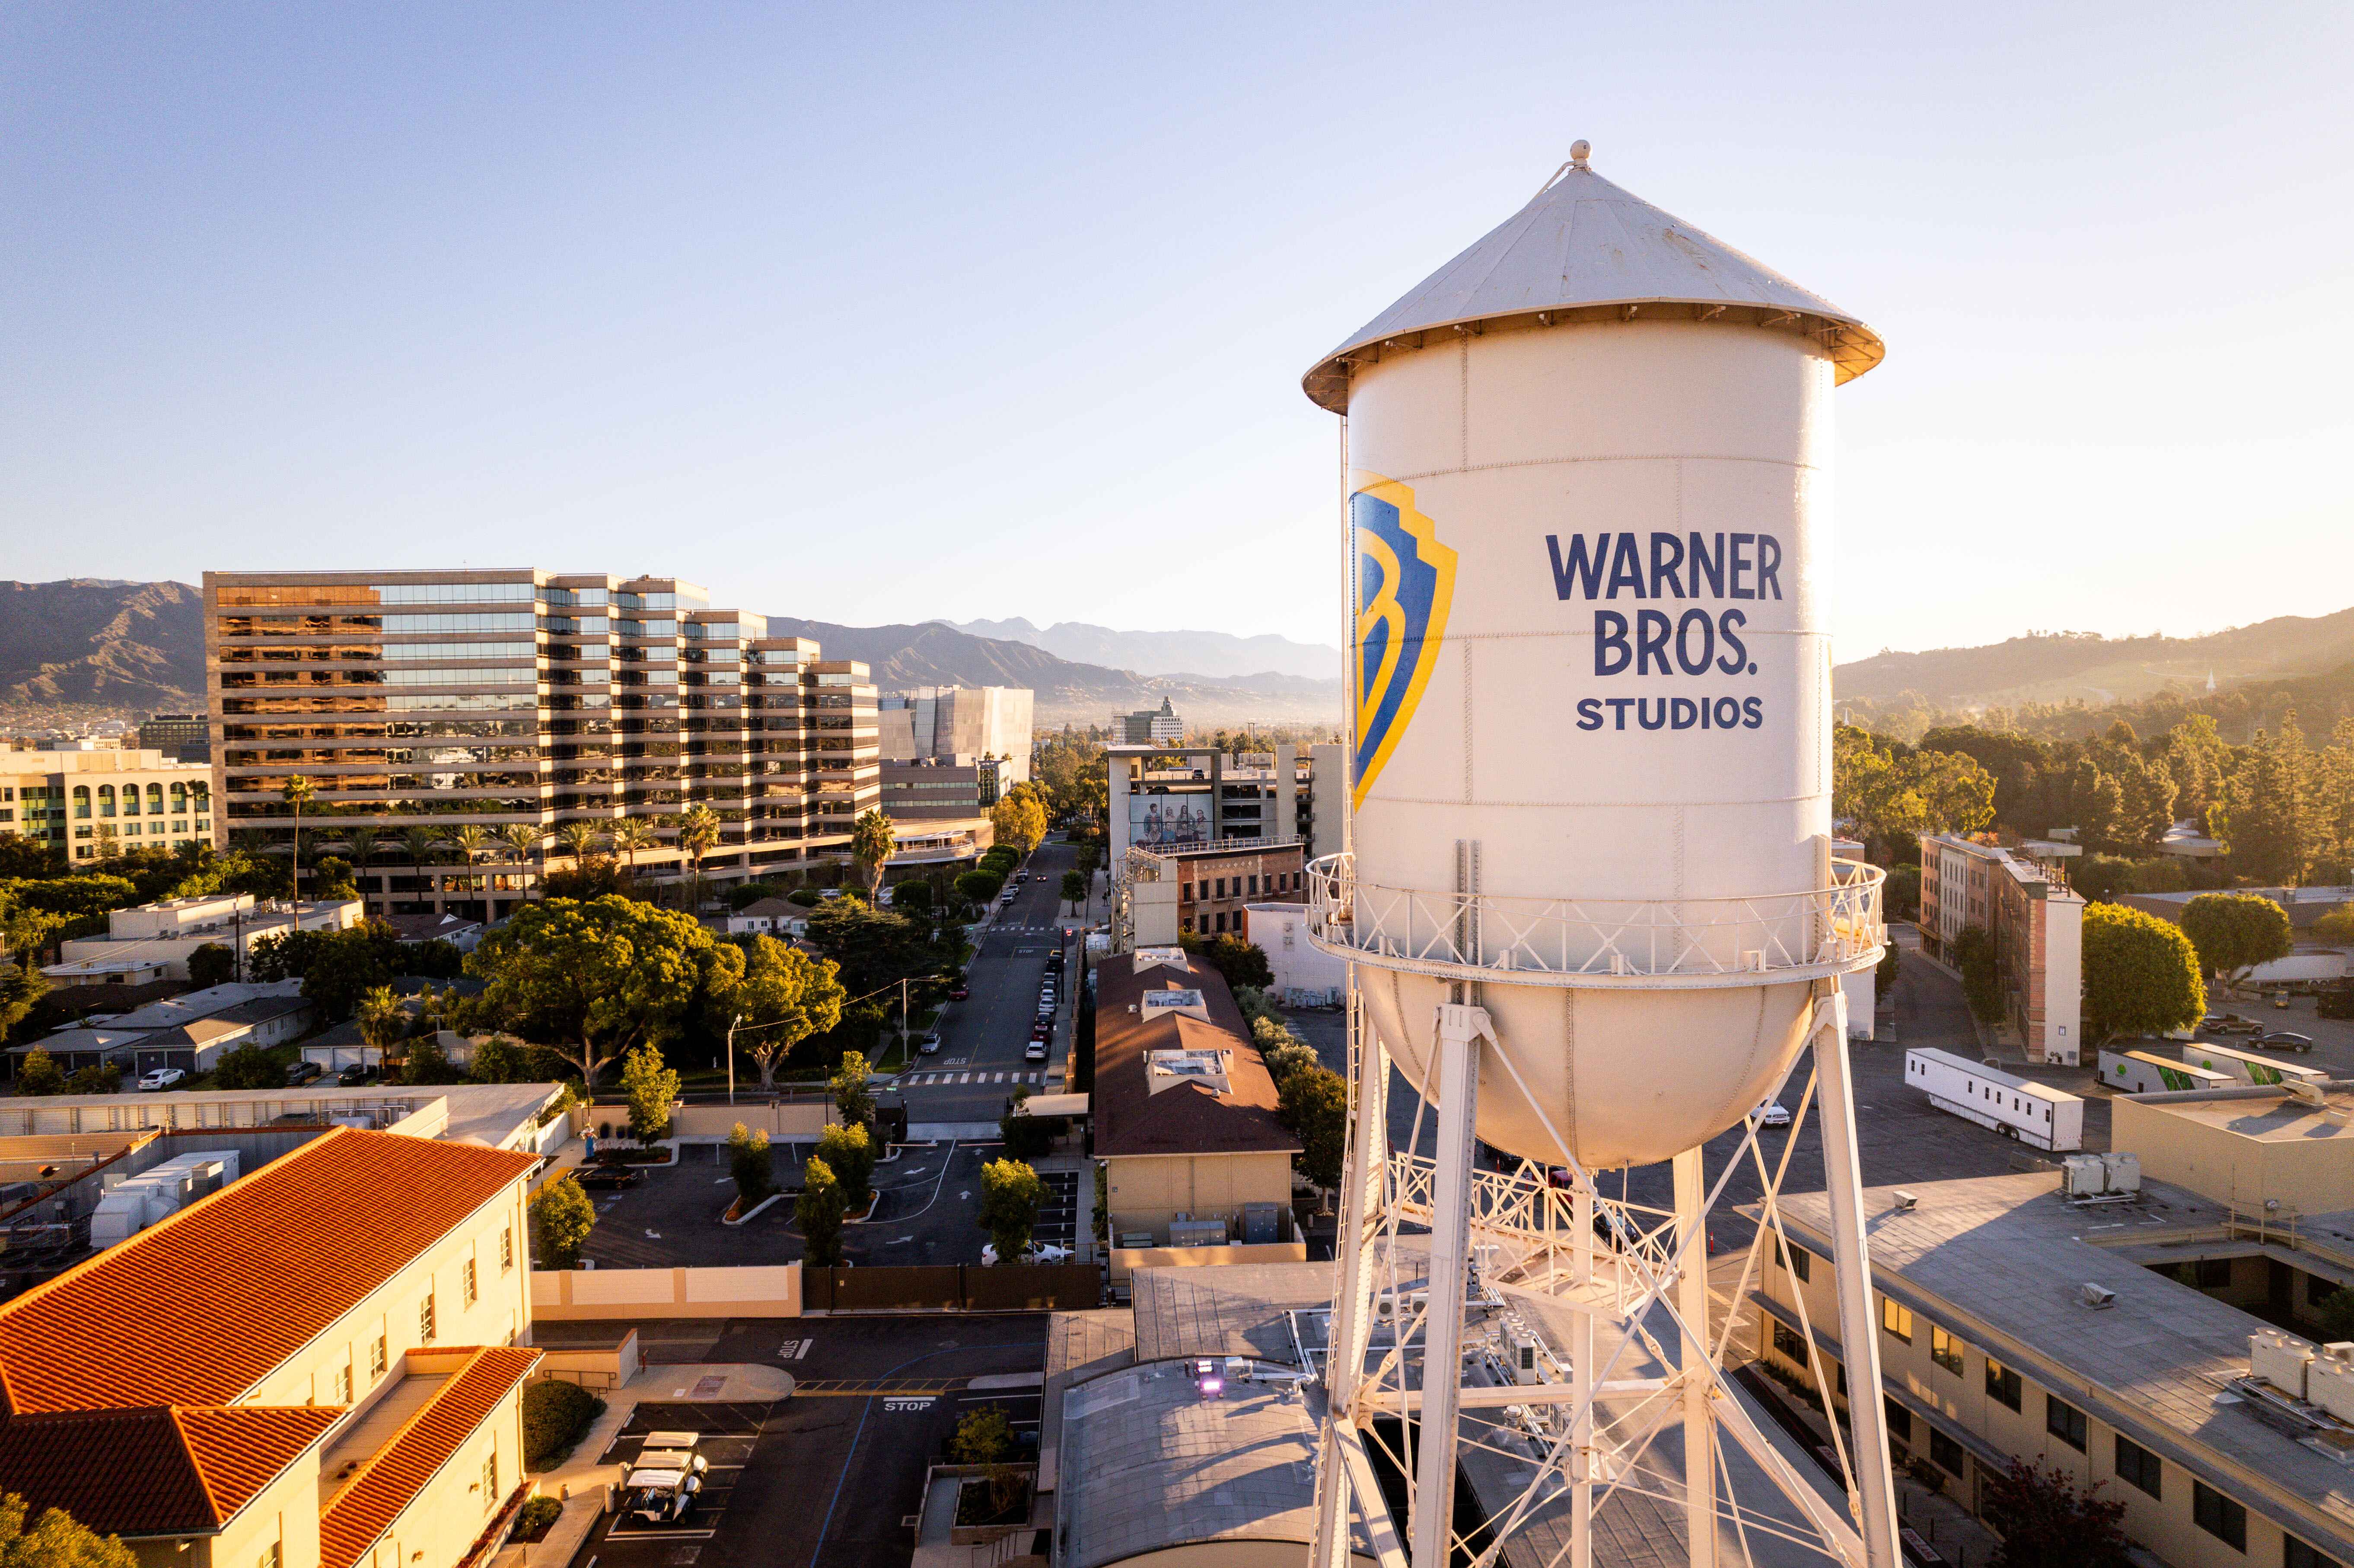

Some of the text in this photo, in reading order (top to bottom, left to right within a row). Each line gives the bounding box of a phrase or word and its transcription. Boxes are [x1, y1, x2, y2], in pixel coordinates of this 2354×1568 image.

[1545, 531, 1783, 601] WARNER
[1594, 608, 1758, 676] BROS.
[1576, 696, 1763, 731] STUDIOS
[777, 1340, 799, 1358] STOP
[885, 1402, 931, 1411] STOP
[1905, 1530, 1937, 1560] FIRE LANE
